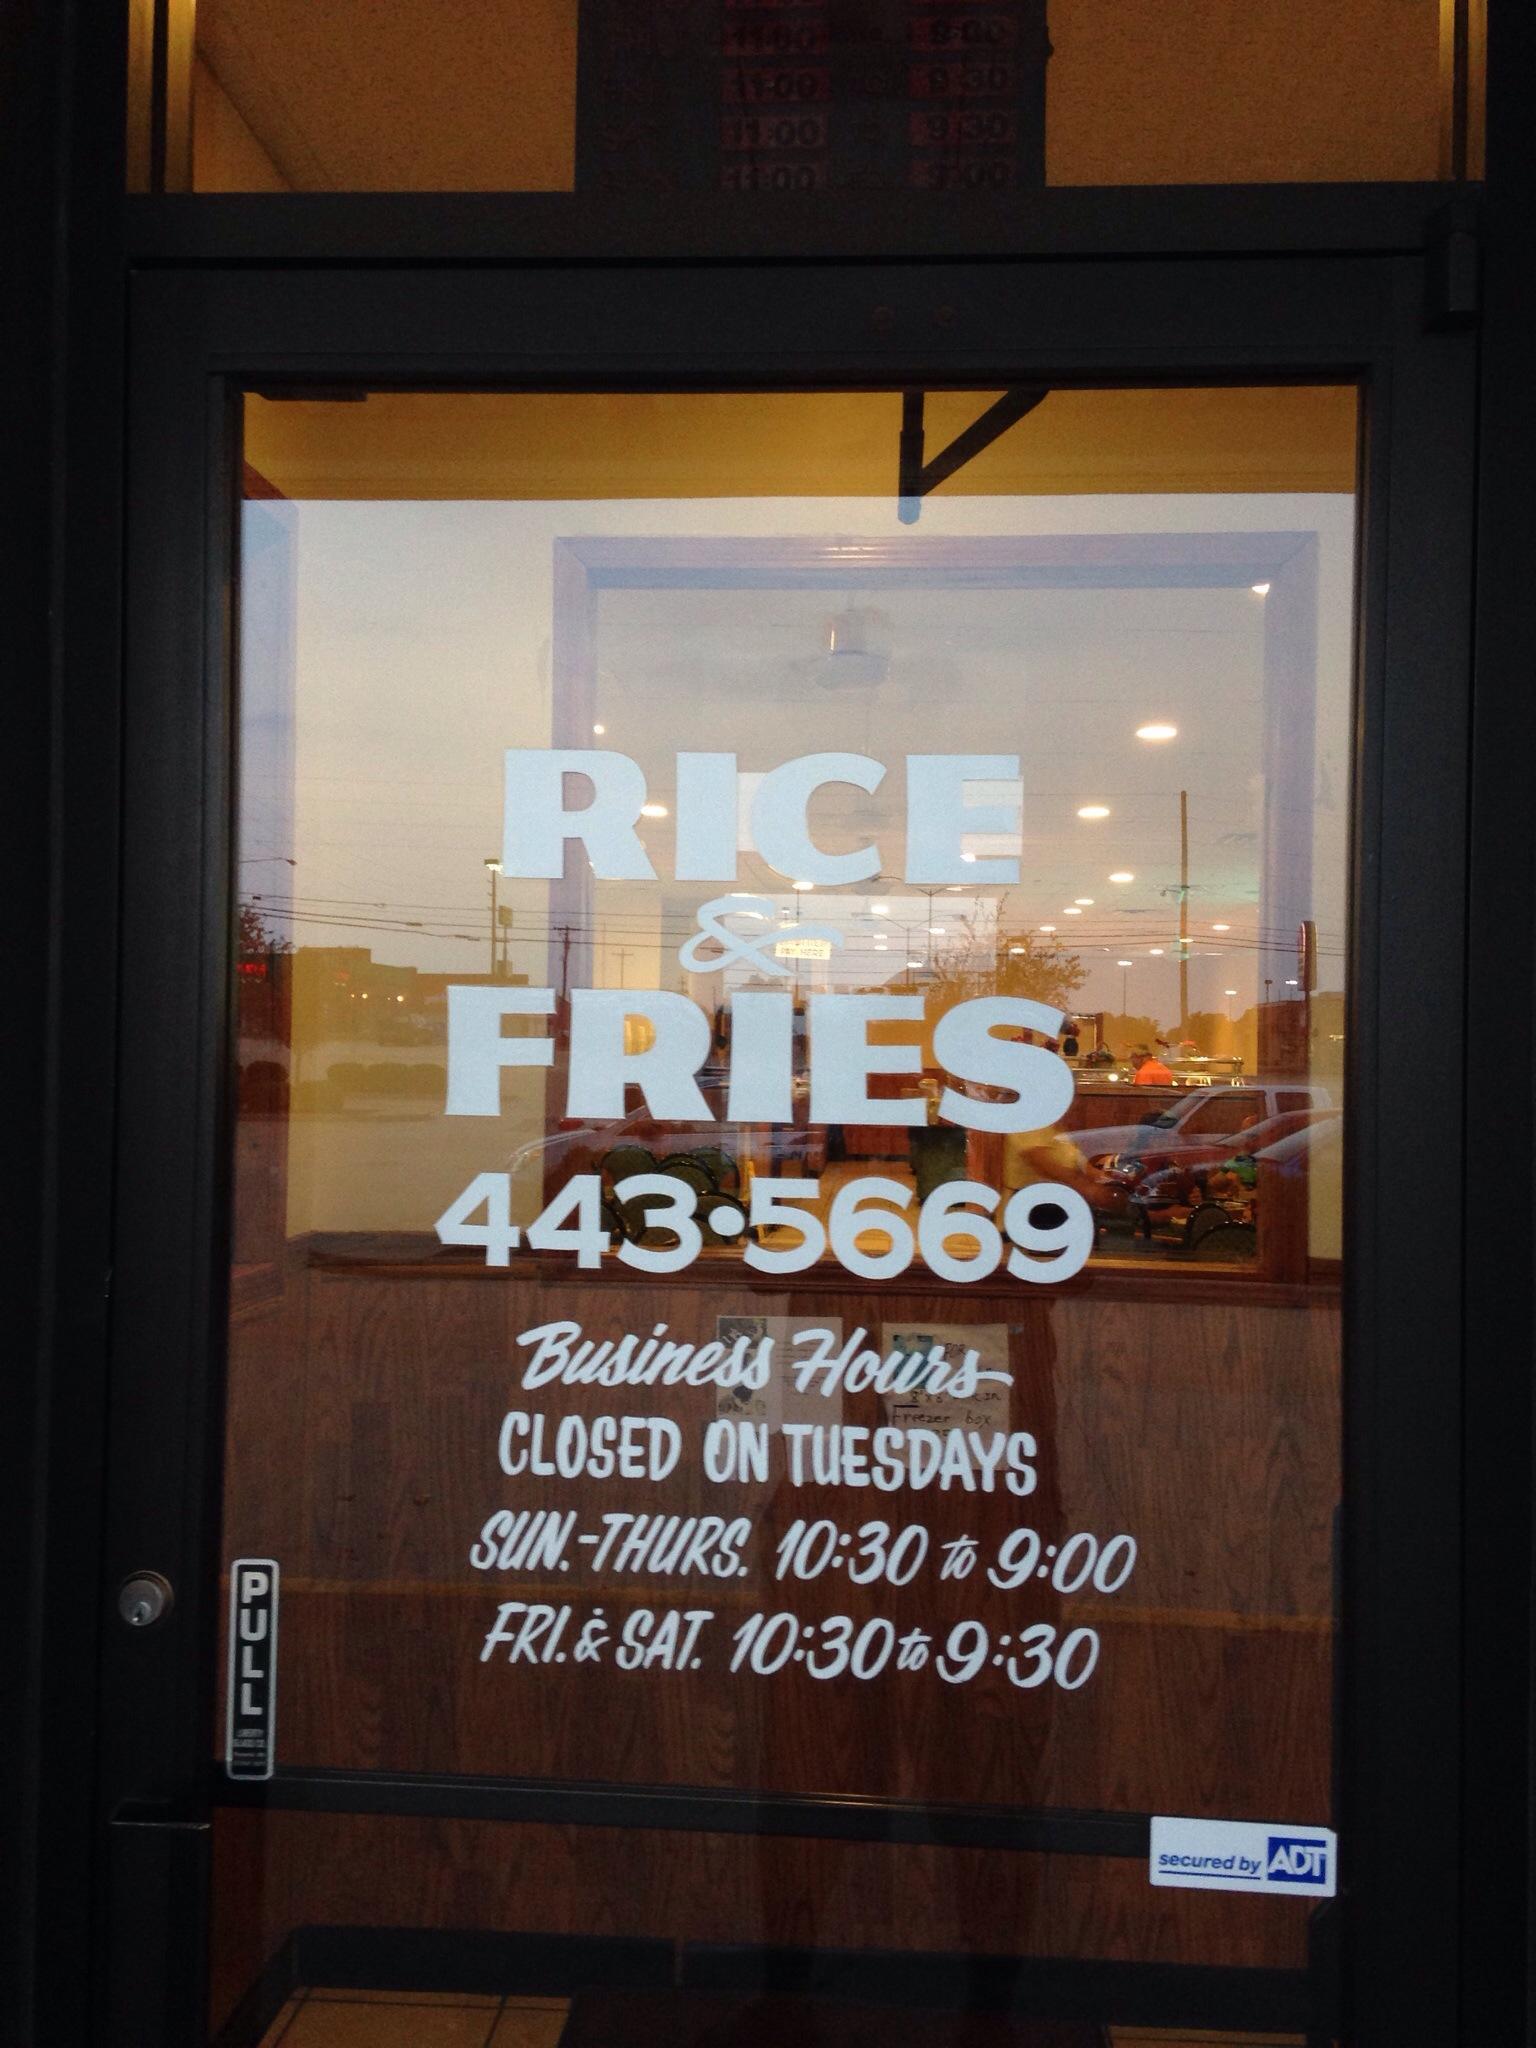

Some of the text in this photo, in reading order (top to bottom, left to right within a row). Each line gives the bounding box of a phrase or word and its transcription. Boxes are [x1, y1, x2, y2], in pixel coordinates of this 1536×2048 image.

[503, 750, 1021, 886] RICE
[679, 893, 844, 976] &
[444, 985, 1076, 1133] FRIES
[516, 1320, 776, 1391] Business
[791, 1327, 1014, 1399] Hours
[499, 1411, 1037, 1497] CLOSED ON TUESDAYS
[776, 1519, 928, 1586] 10:30
[941, 1534, 978, 1580] to
[987, 1528, 1138, 1593] 9:00
[240, 1571, 269, 1716] PULL
[615, 1609, 714, 1673] SAT.
[730, 1612, 895, 1681] 10:30
[897, 1627, 931, 1671] to
[936, 1620, 1099, 1690] 9:30
[1158, 1844, 1327, 1878] secured by ADT
